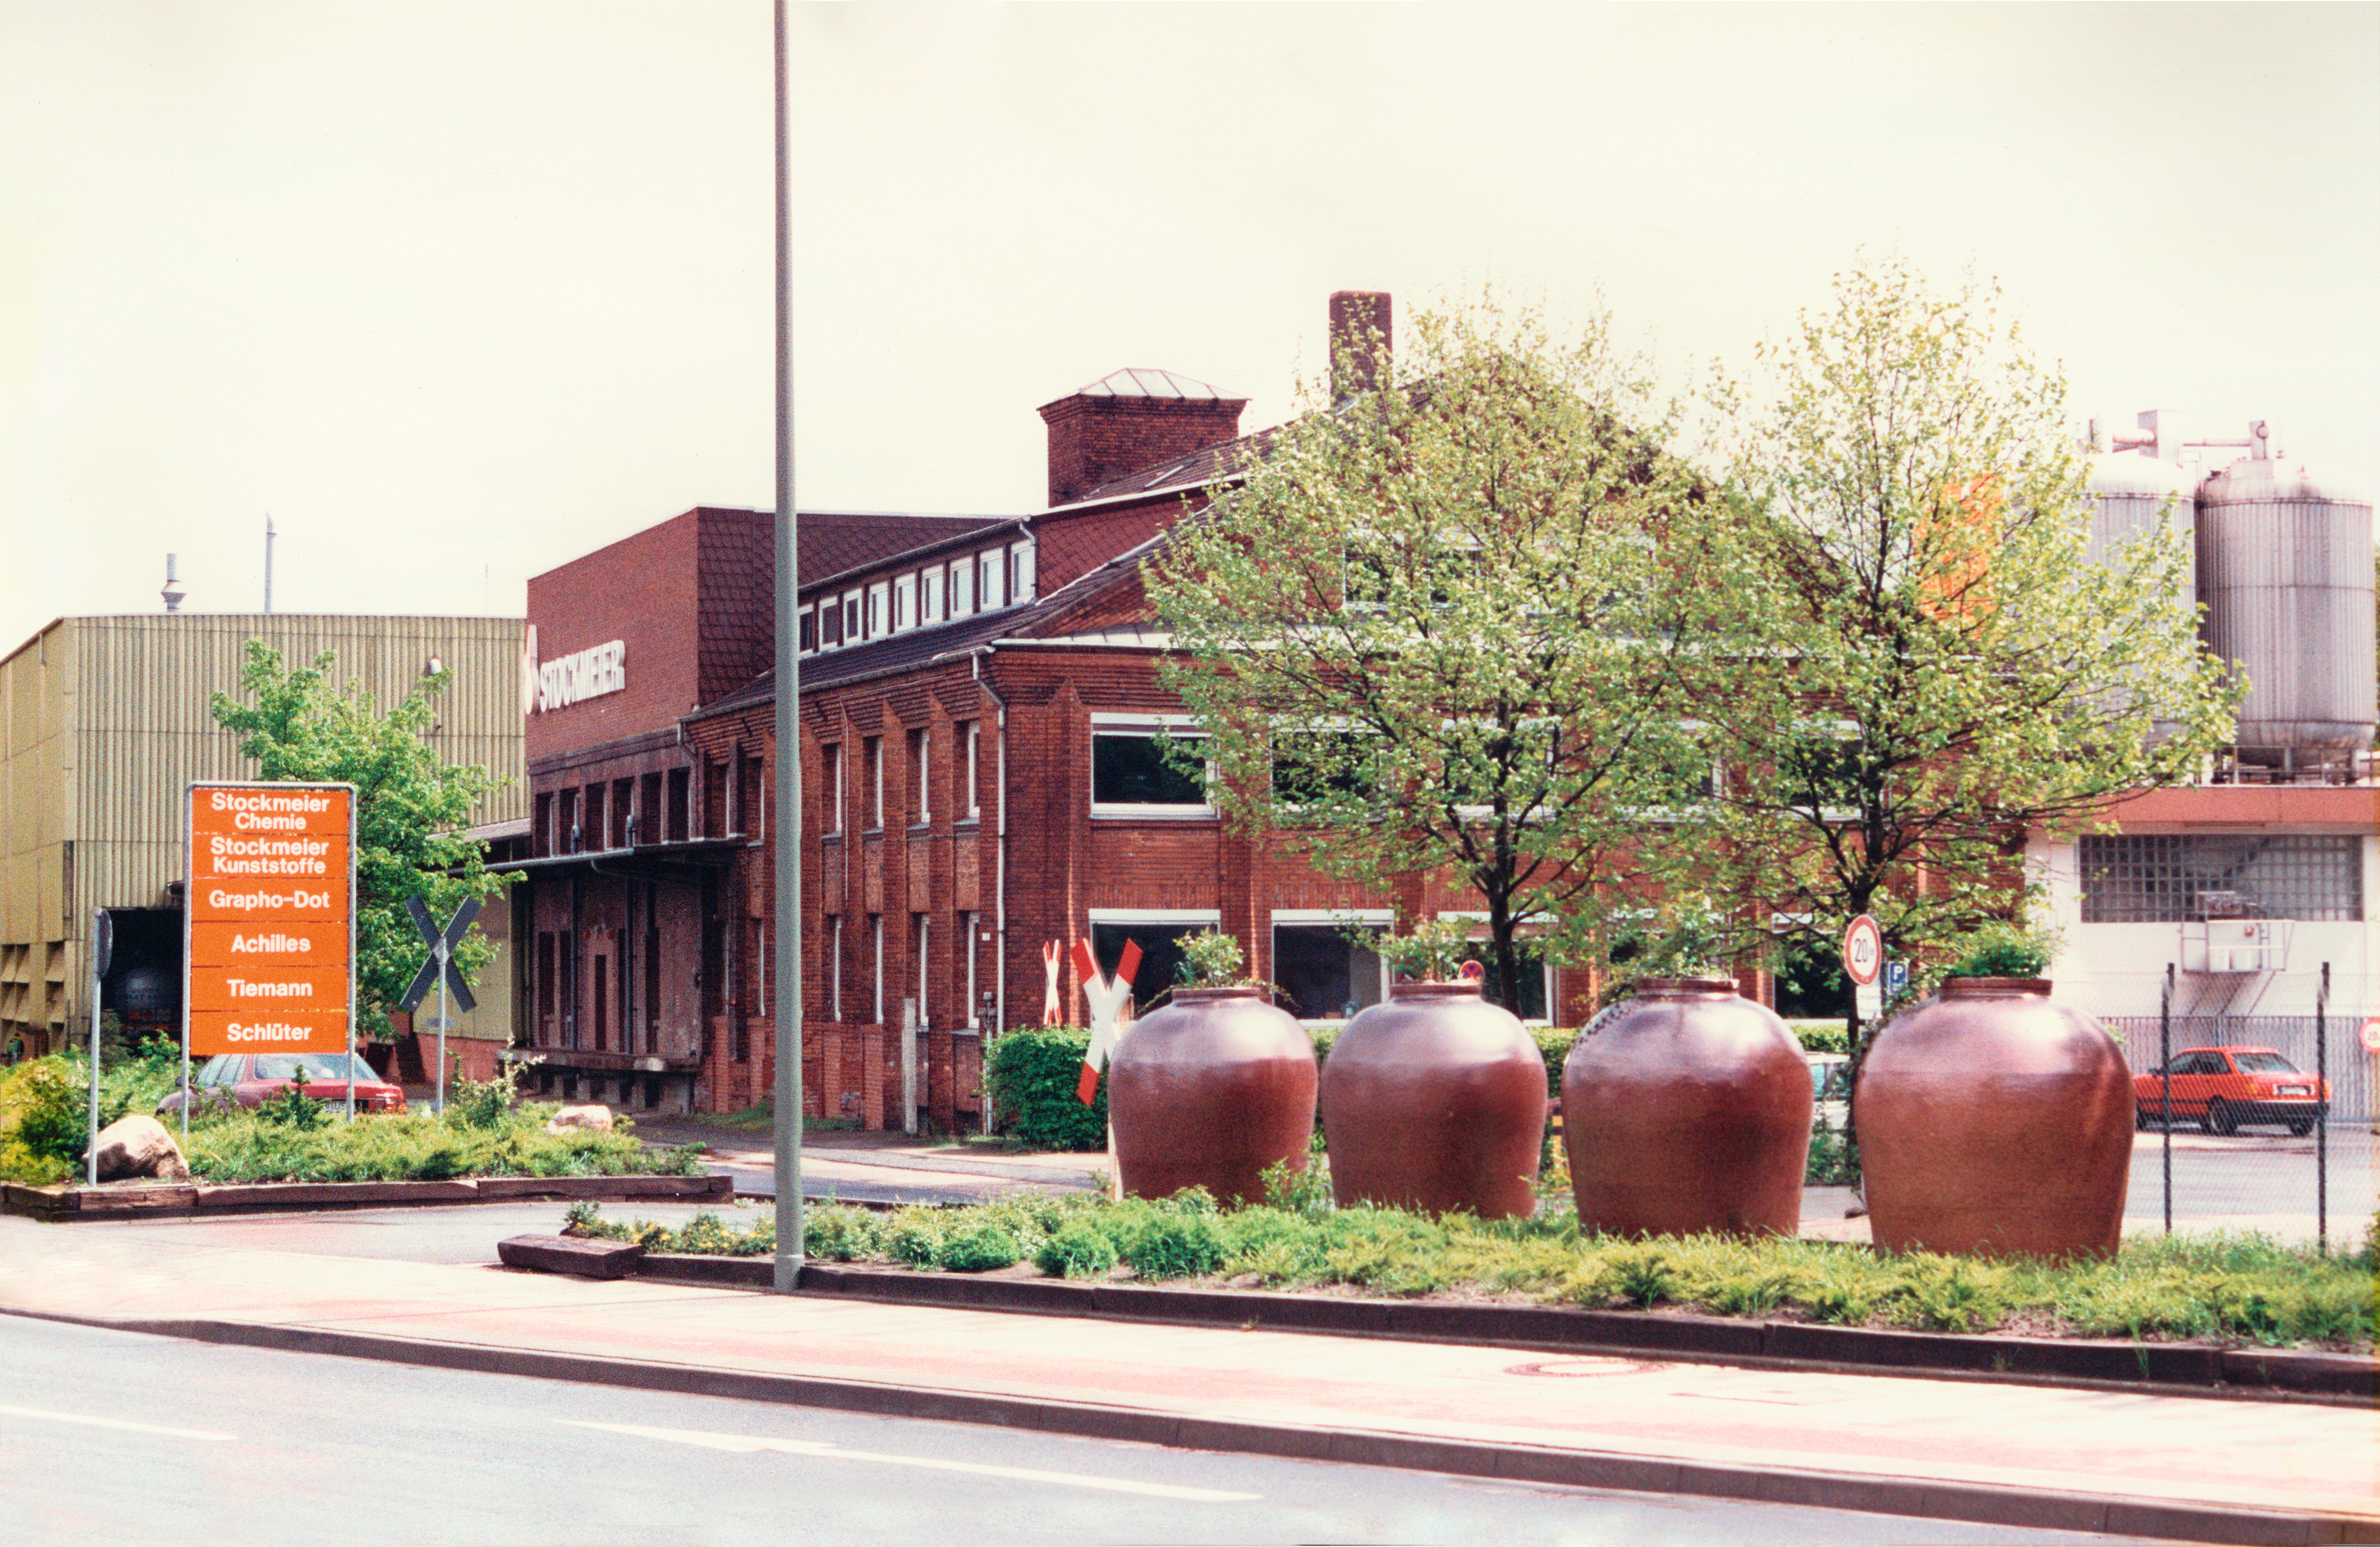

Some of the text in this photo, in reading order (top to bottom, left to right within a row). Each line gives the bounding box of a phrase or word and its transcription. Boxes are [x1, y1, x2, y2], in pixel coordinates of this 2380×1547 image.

[211, 792, 330, 812] Stockmeier
[235, 812, 306, 830] Chemie
[211, 836, 329, 855] Stockmeier
[214, 856, 326, 873] Kunststoffe
[210, 890, 330, 911] Grapho-Dot
[231, 934, 310, 952] Achilles
[1855, 938, 1868, 962] 20
[1894, 966, 1903, 980] P
[227, 979, 312, 996] Tiemann
[227, 1023, 312, 1041] Schlüter
